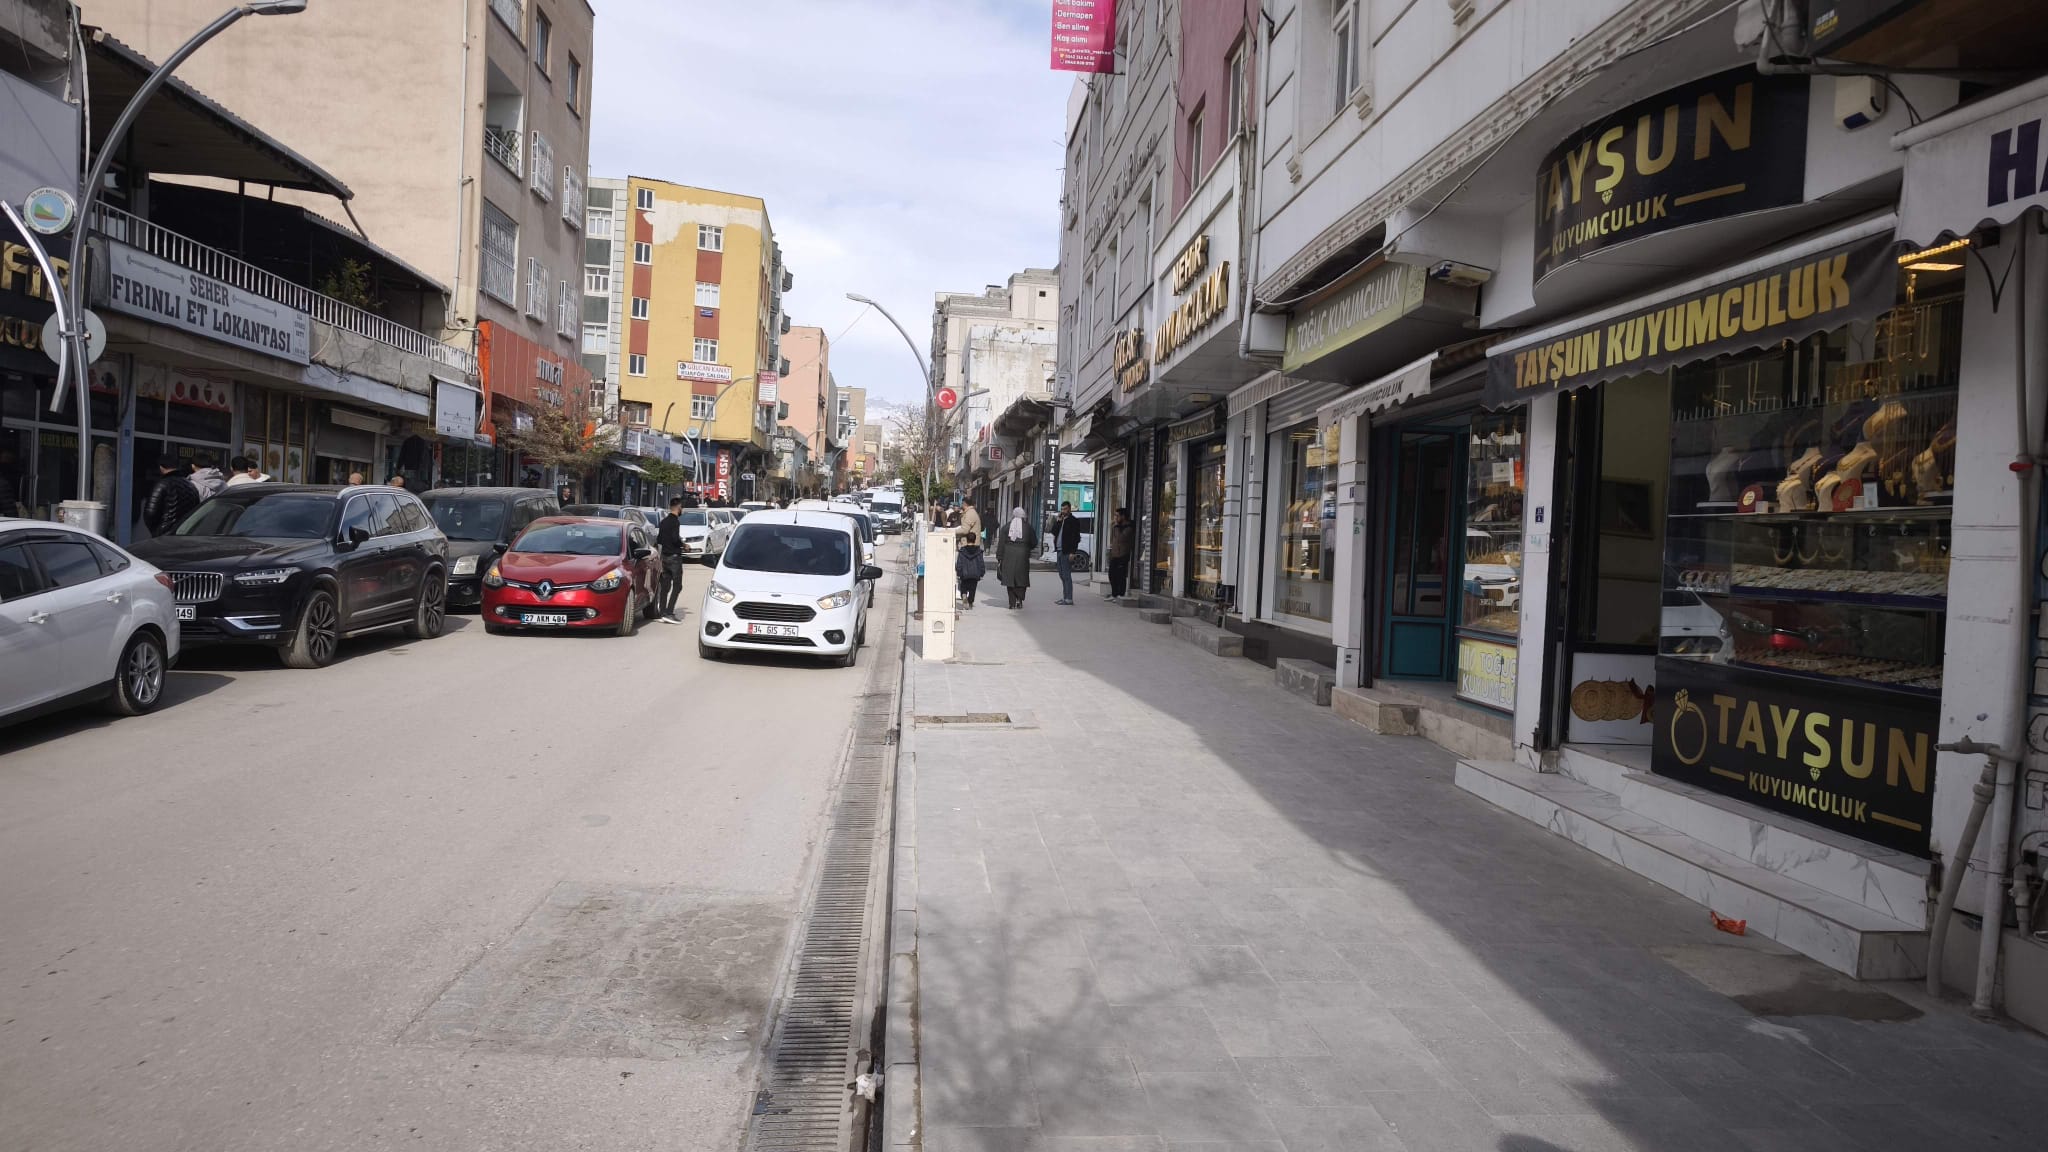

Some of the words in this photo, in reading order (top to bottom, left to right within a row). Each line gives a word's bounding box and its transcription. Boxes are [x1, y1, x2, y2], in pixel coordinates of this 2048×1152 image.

[1987, 119, 2048, 207] H
[1552, 194, 1667, 257] KUYUMCULUK
[111, 273, 180, 320] FIRINLI
[186, 299, 207, 327] ET
[213, 307, 291, 354] LOKANTASI
[189, 274, 229, 307] SEHER
[1297, 309, 1328, 352] TOĞUÇ
[1328, 266, 1403, 337] KUYUMCULUK
[1515, 330, 1600, 389] TAYŞUN
[1605, 252, 1850, 367] KUYUMCULUK
[176, 608, 193, 619] 149
[525, 614, 534, 622] 27
[753, 625, 762, 634] 34
[766, 626, 778, 635] GIS
[1713, 694, 1929, 794] TAYŞUN
[1749, 771, 1866, 823] KUYUMCULUK
